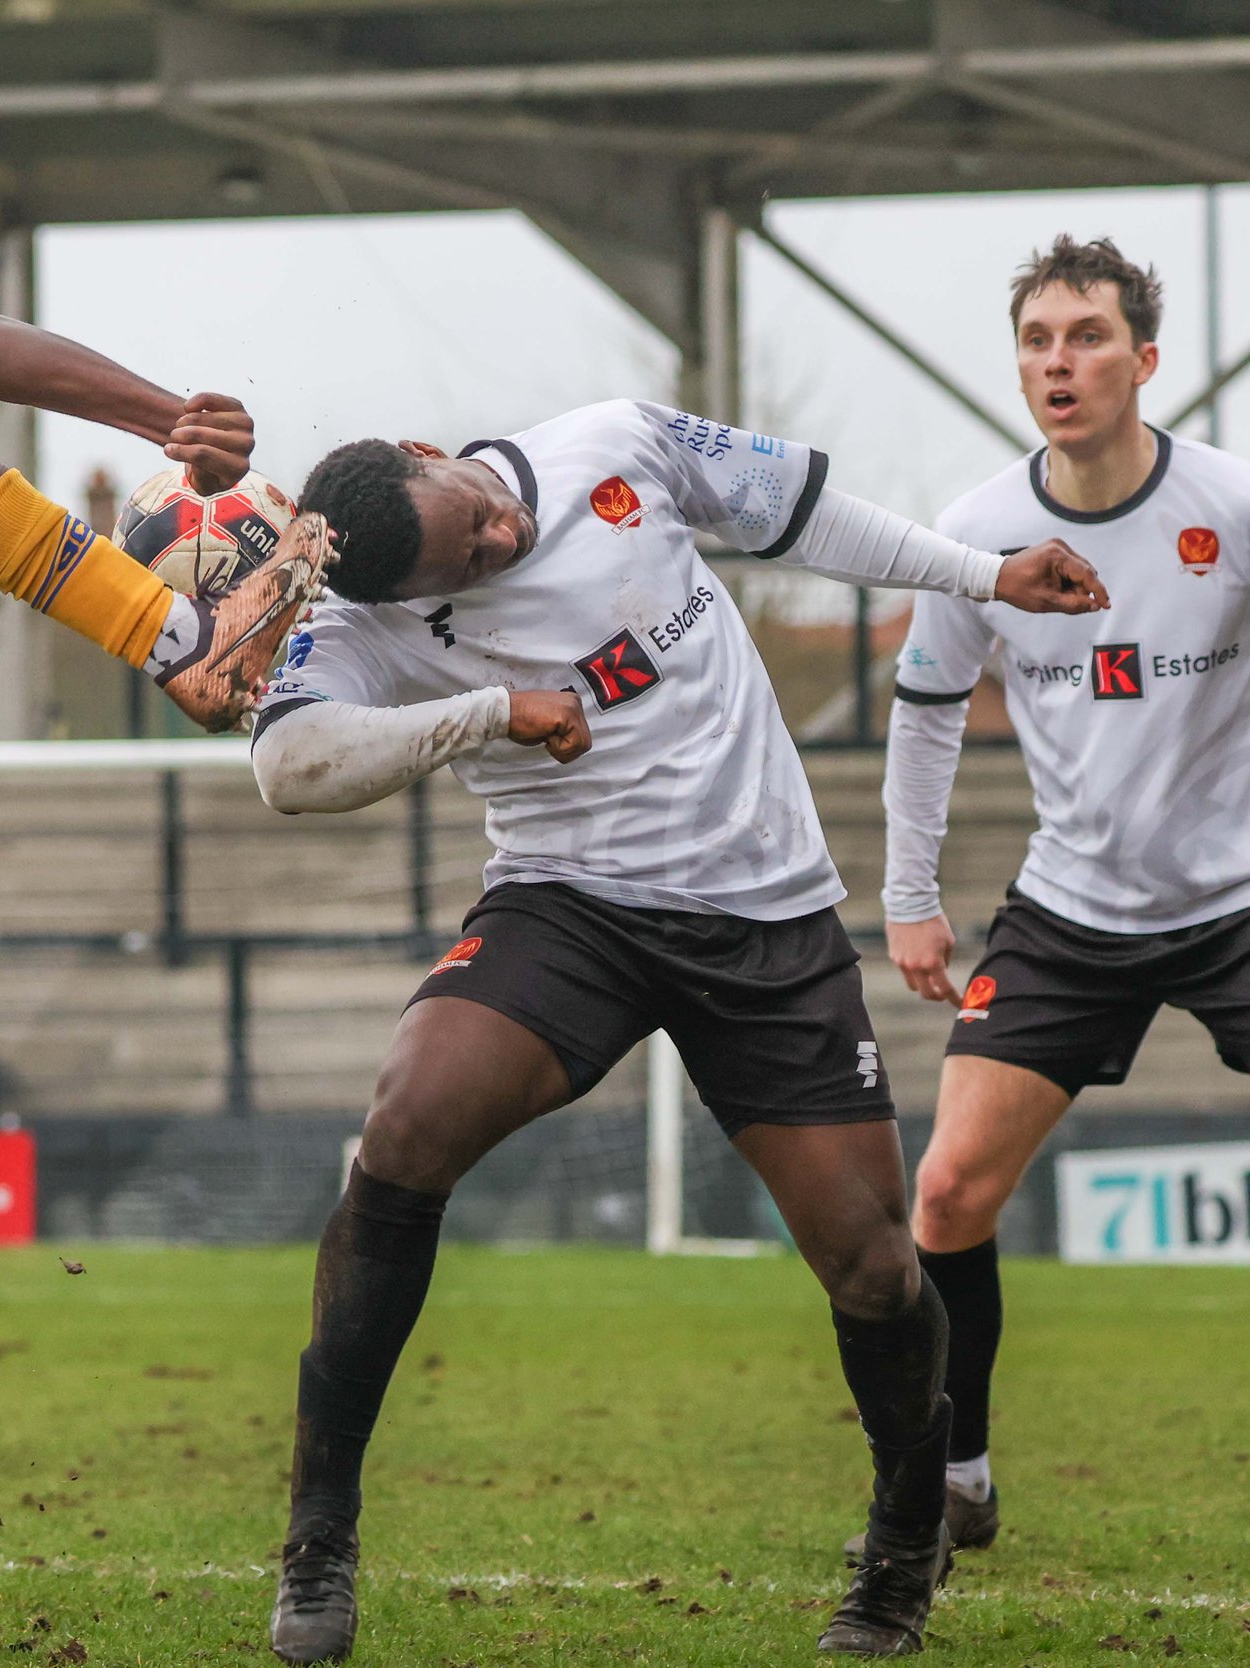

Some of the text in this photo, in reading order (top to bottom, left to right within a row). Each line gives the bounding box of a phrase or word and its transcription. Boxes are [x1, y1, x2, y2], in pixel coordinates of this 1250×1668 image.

[648, 586, 715, 653] Estates
[1096, 649, 1140, 694] K
[1153, 642, 1240, 678] Estates
